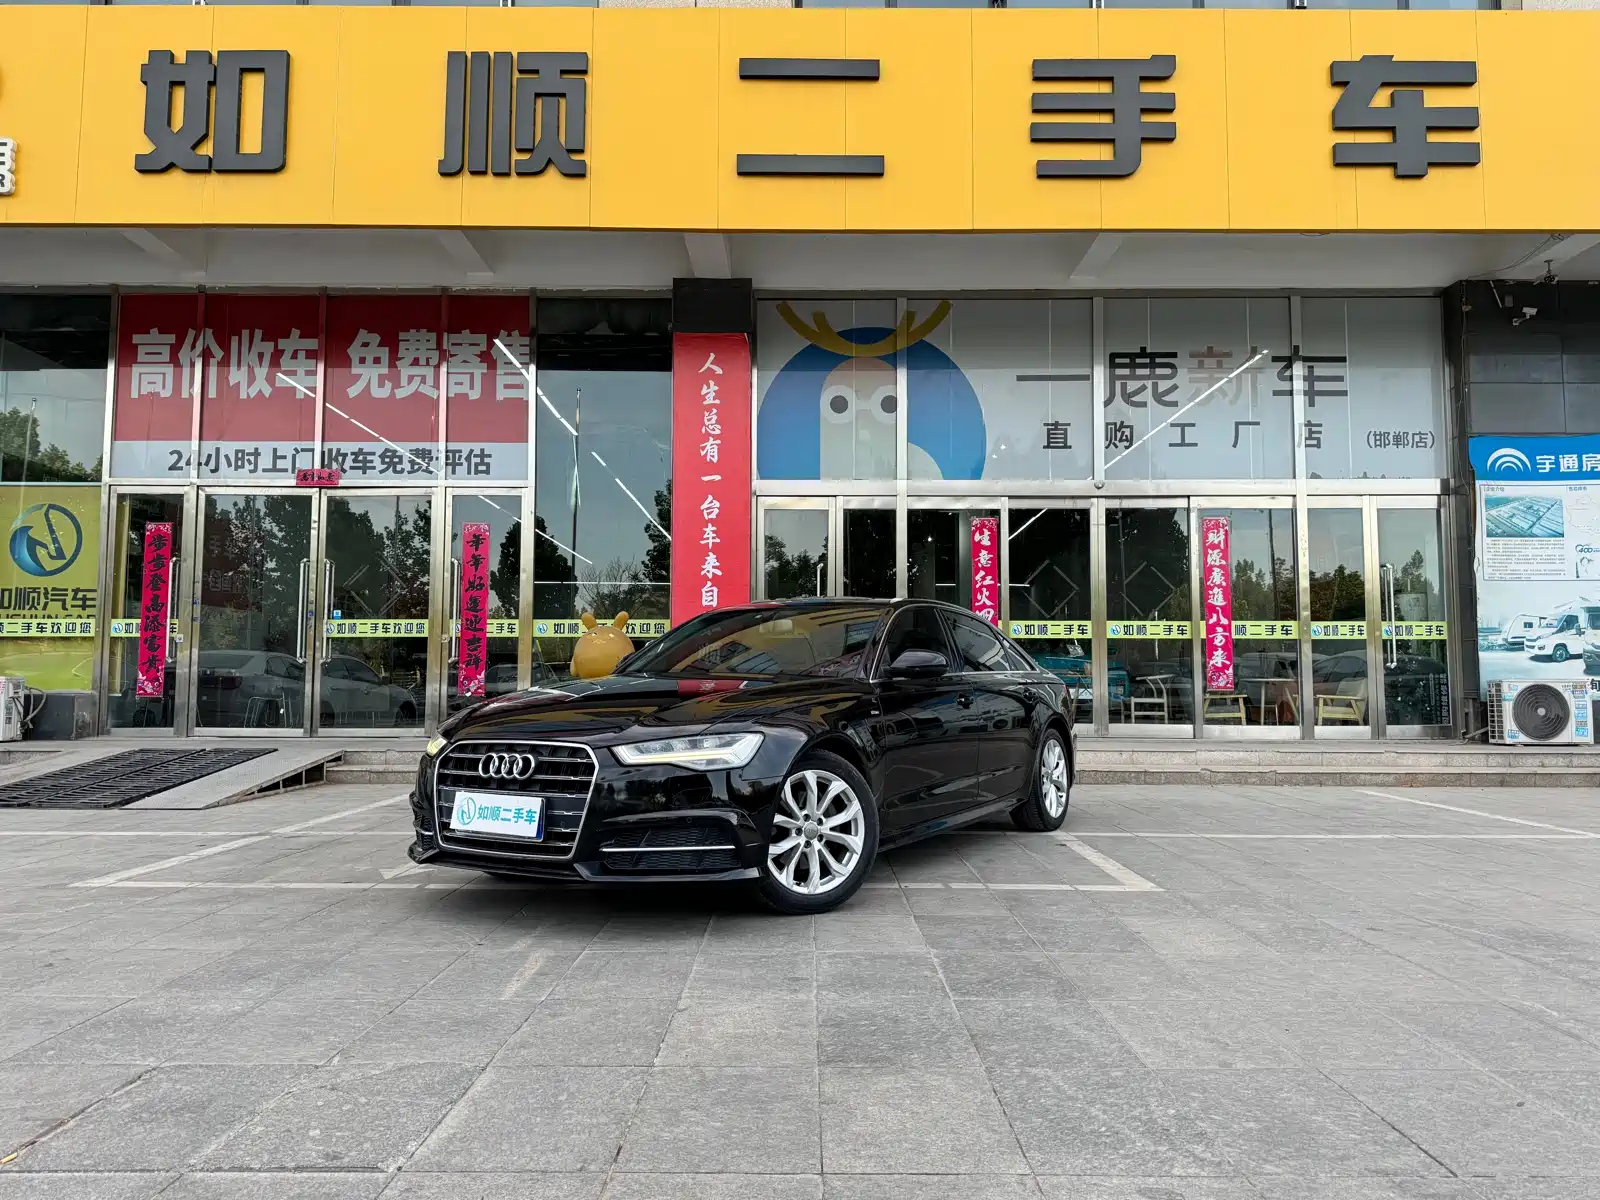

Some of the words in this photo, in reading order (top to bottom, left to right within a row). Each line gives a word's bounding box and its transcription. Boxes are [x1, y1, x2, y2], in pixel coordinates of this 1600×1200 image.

[135, 50, 1480, 180] 如顺二手车
[130, 327, 319, 399] 高价收车
[346, 328, 529, 401] 免费寄售
[1016, 345, 1348, 409] 一鹿新车
[1042, 420, 1322, 450] 直购工厂店
[698, 353, 723, 607] 人生总有一台车来自
[336, 622, 425, 635] 如顺二手车欢迎您
[1024, 624, 1088, 636] 如顺二手车
[1122, 624, 1188, 636] 如顺二手车
[1323, 624, 1365, 637] 如顺二手车
[476, 804, 537, 825] 如顺二手车
